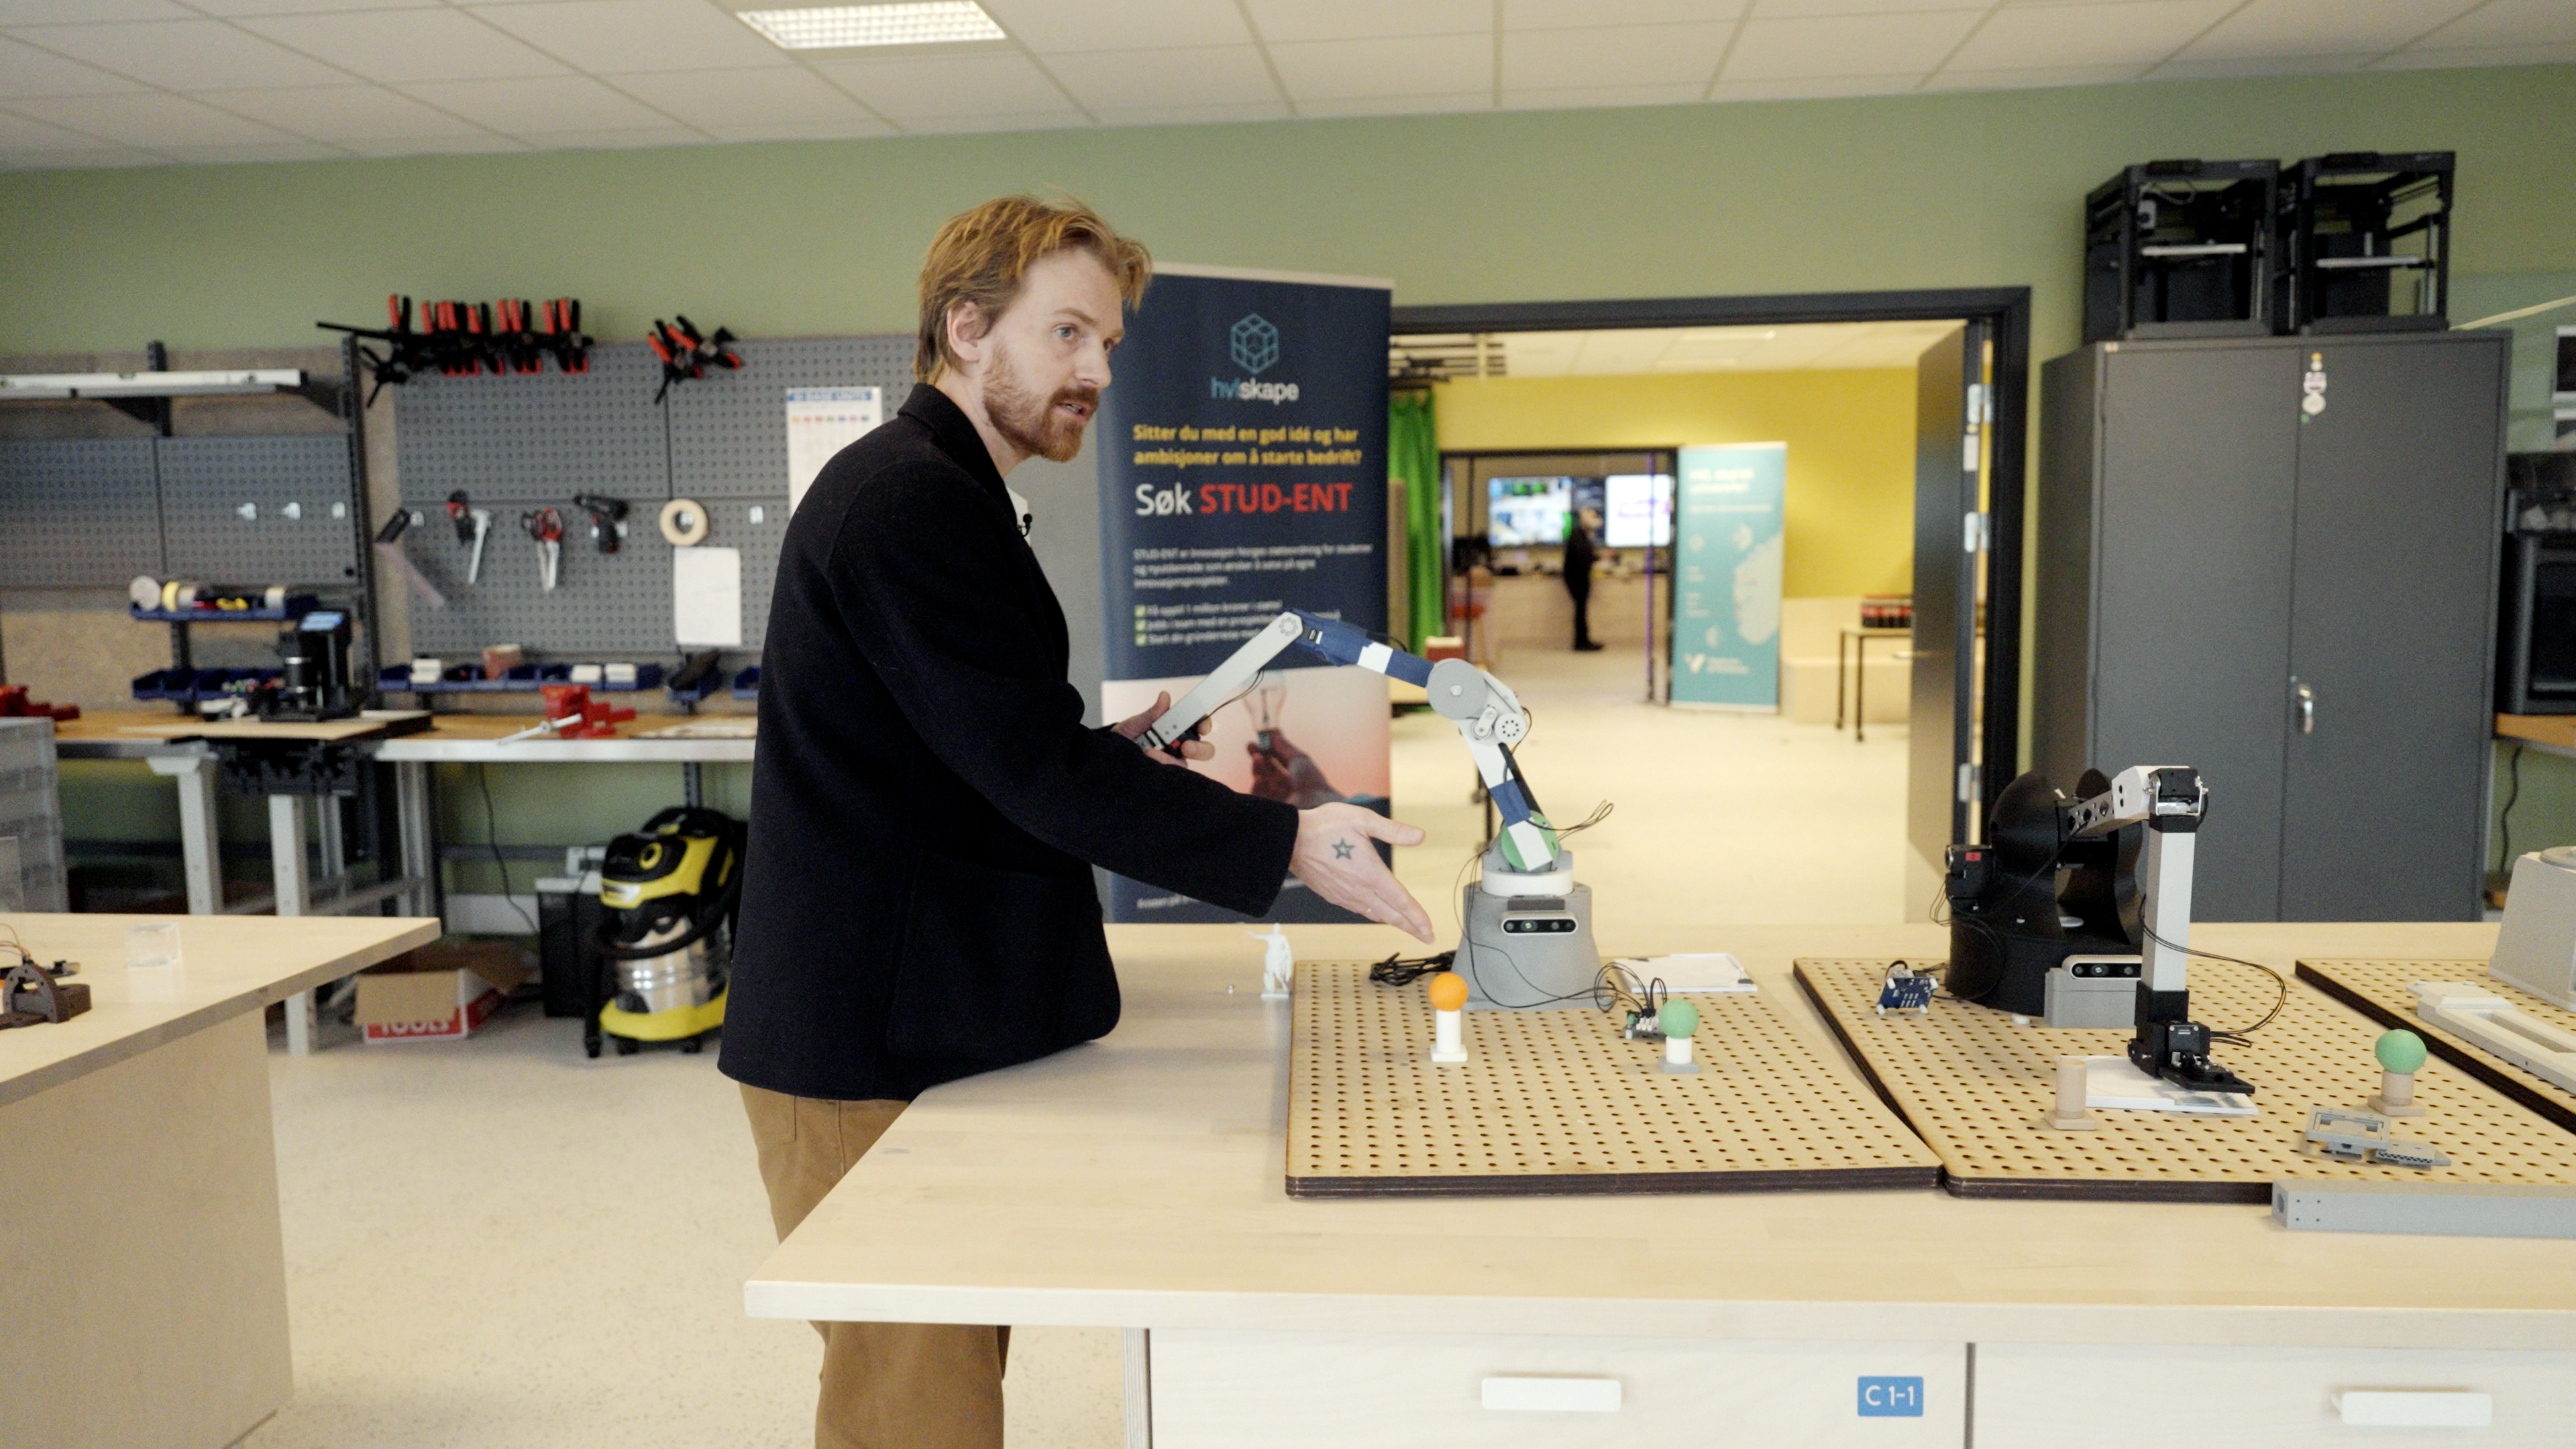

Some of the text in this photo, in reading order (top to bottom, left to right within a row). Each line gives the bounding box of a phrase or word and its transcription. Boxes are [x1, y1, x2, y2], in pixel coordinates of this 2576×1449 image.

[1133, 424, 1358, 446] Sitter du med en god idé og har
[1134, 447, 1362, 468] ambisjoner om å starte bedrift?
[1135, 482, 1353, 516] Søk STUD-ENT
[1865, 1385, 1915, 1407] C 1-1
